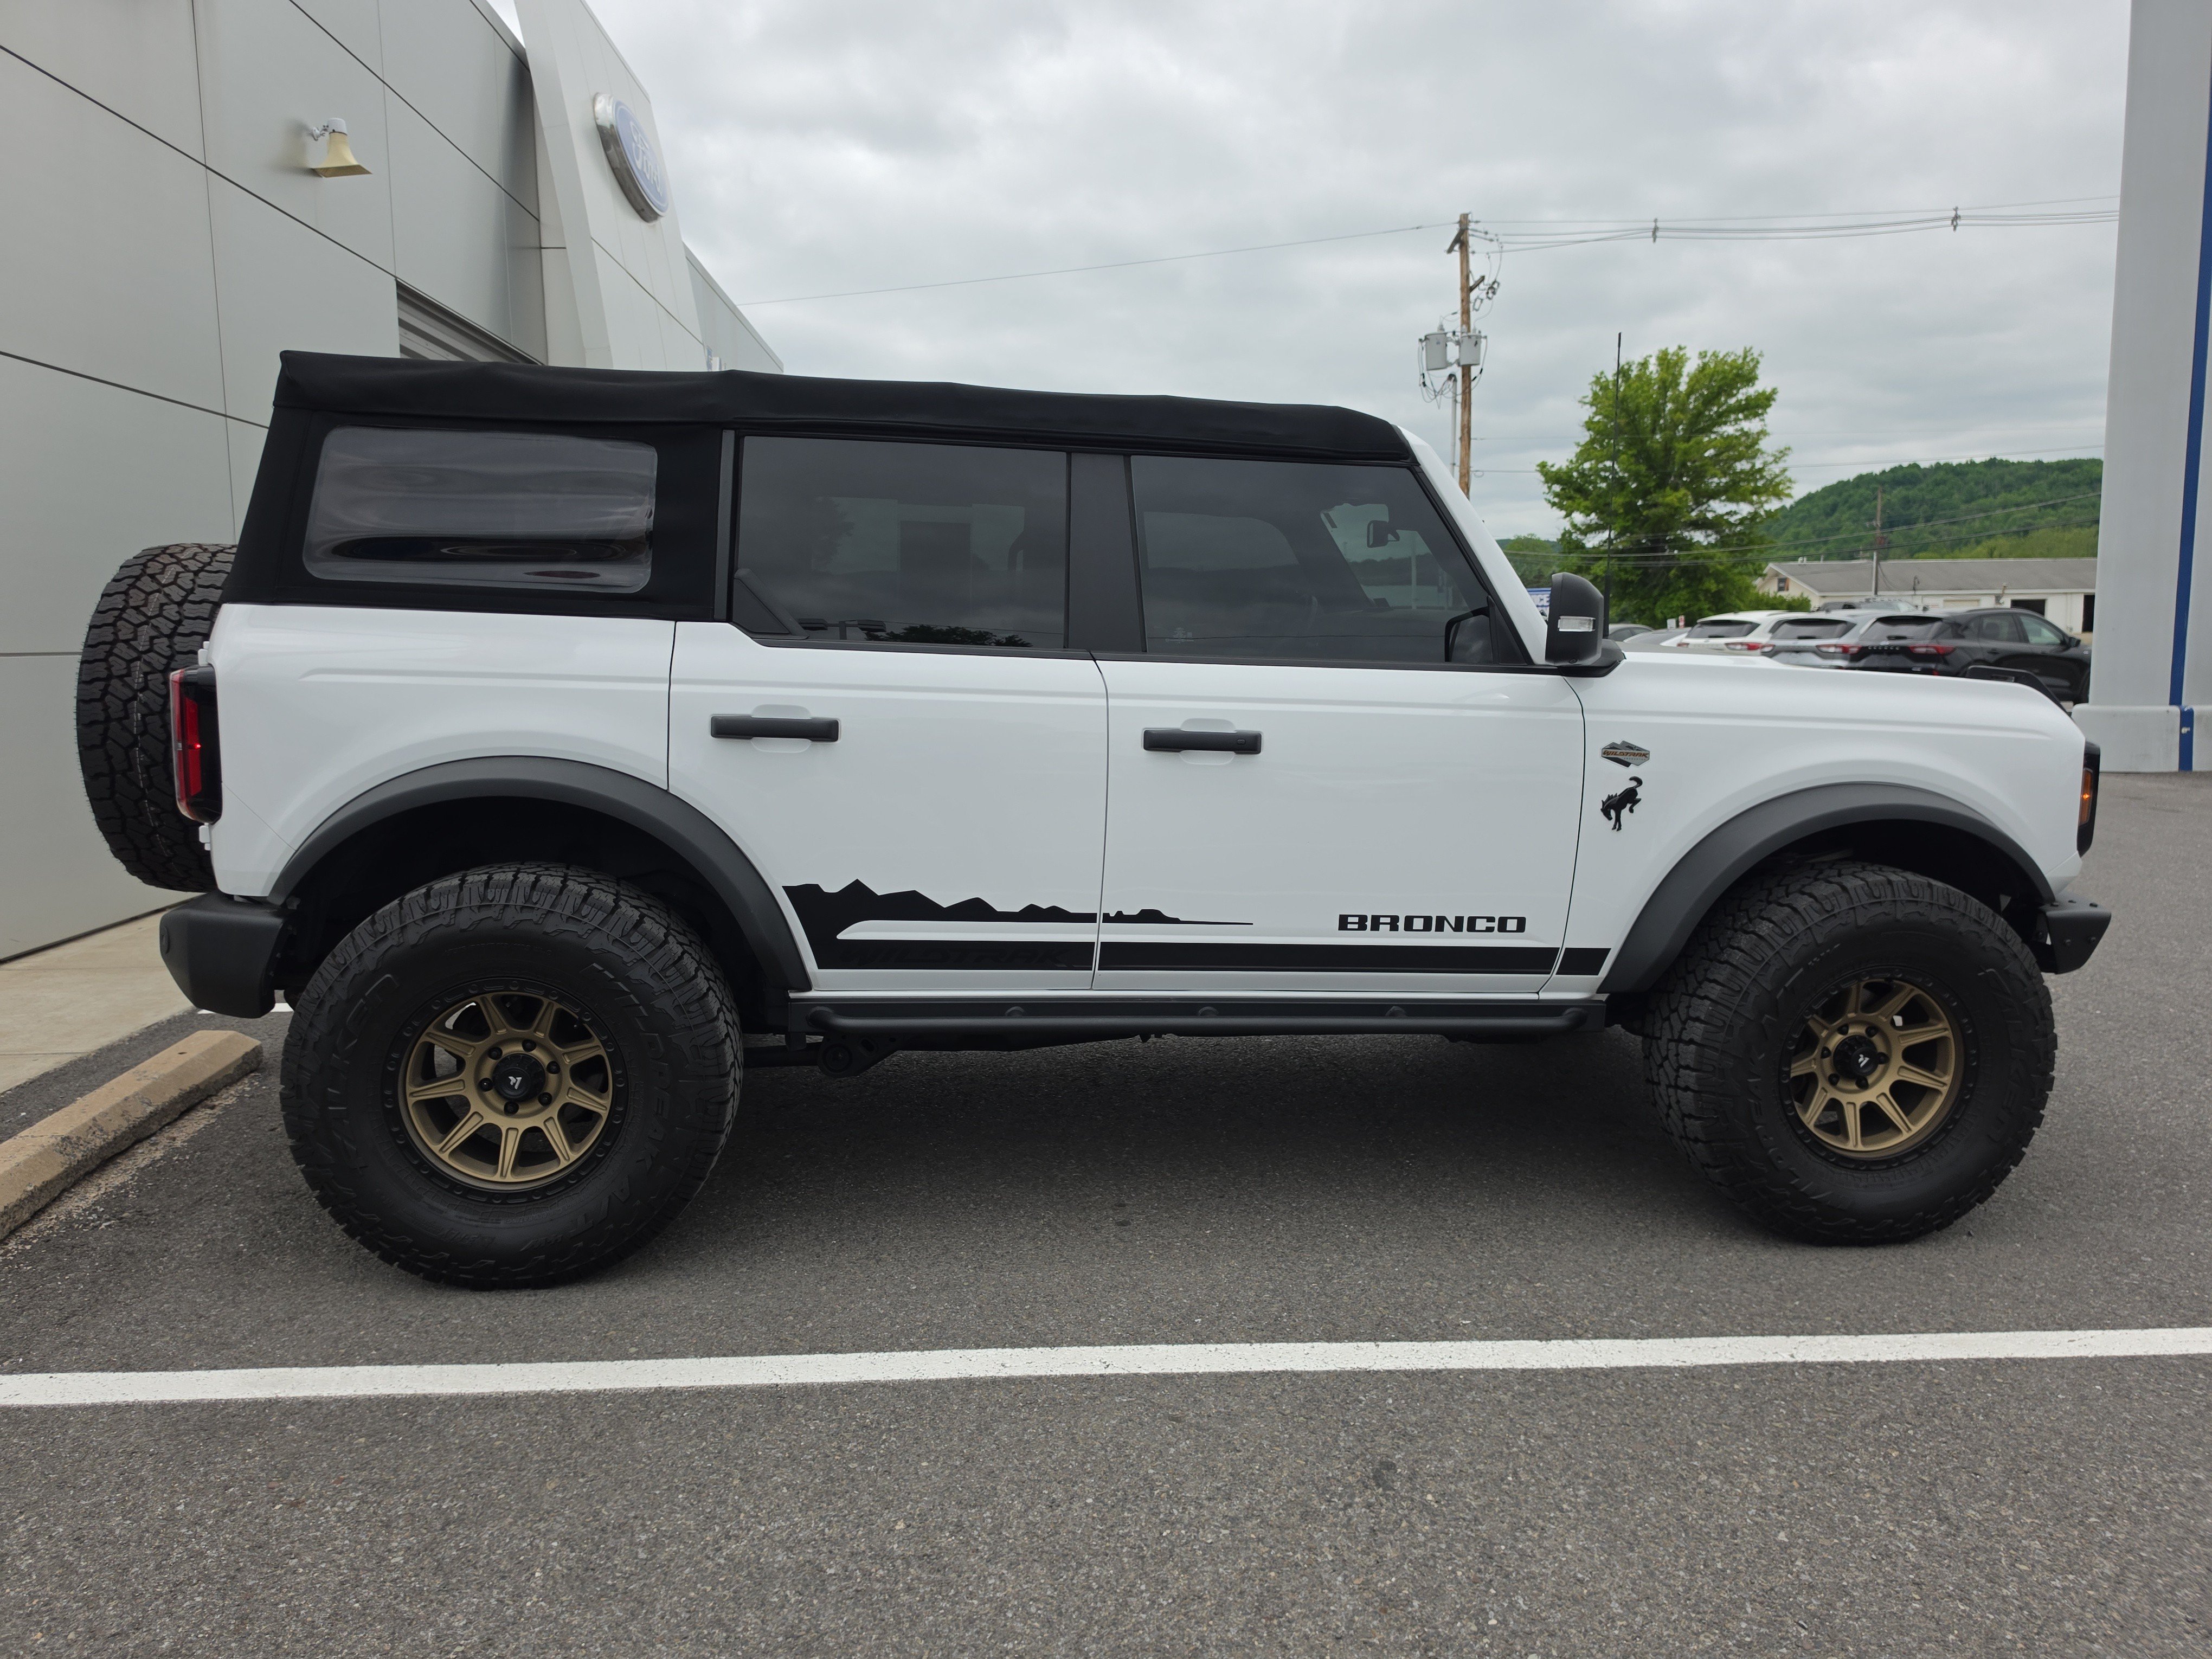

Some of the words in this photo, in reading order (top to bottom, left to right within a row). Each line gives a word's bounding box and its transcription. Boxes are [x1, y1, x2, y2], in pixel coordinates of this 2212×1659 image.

[629, 121, 663, 196] Ford
[1338, 914, 1526, 933] BRONCO
[840, 946, 1071, 967] WILDTRAK
